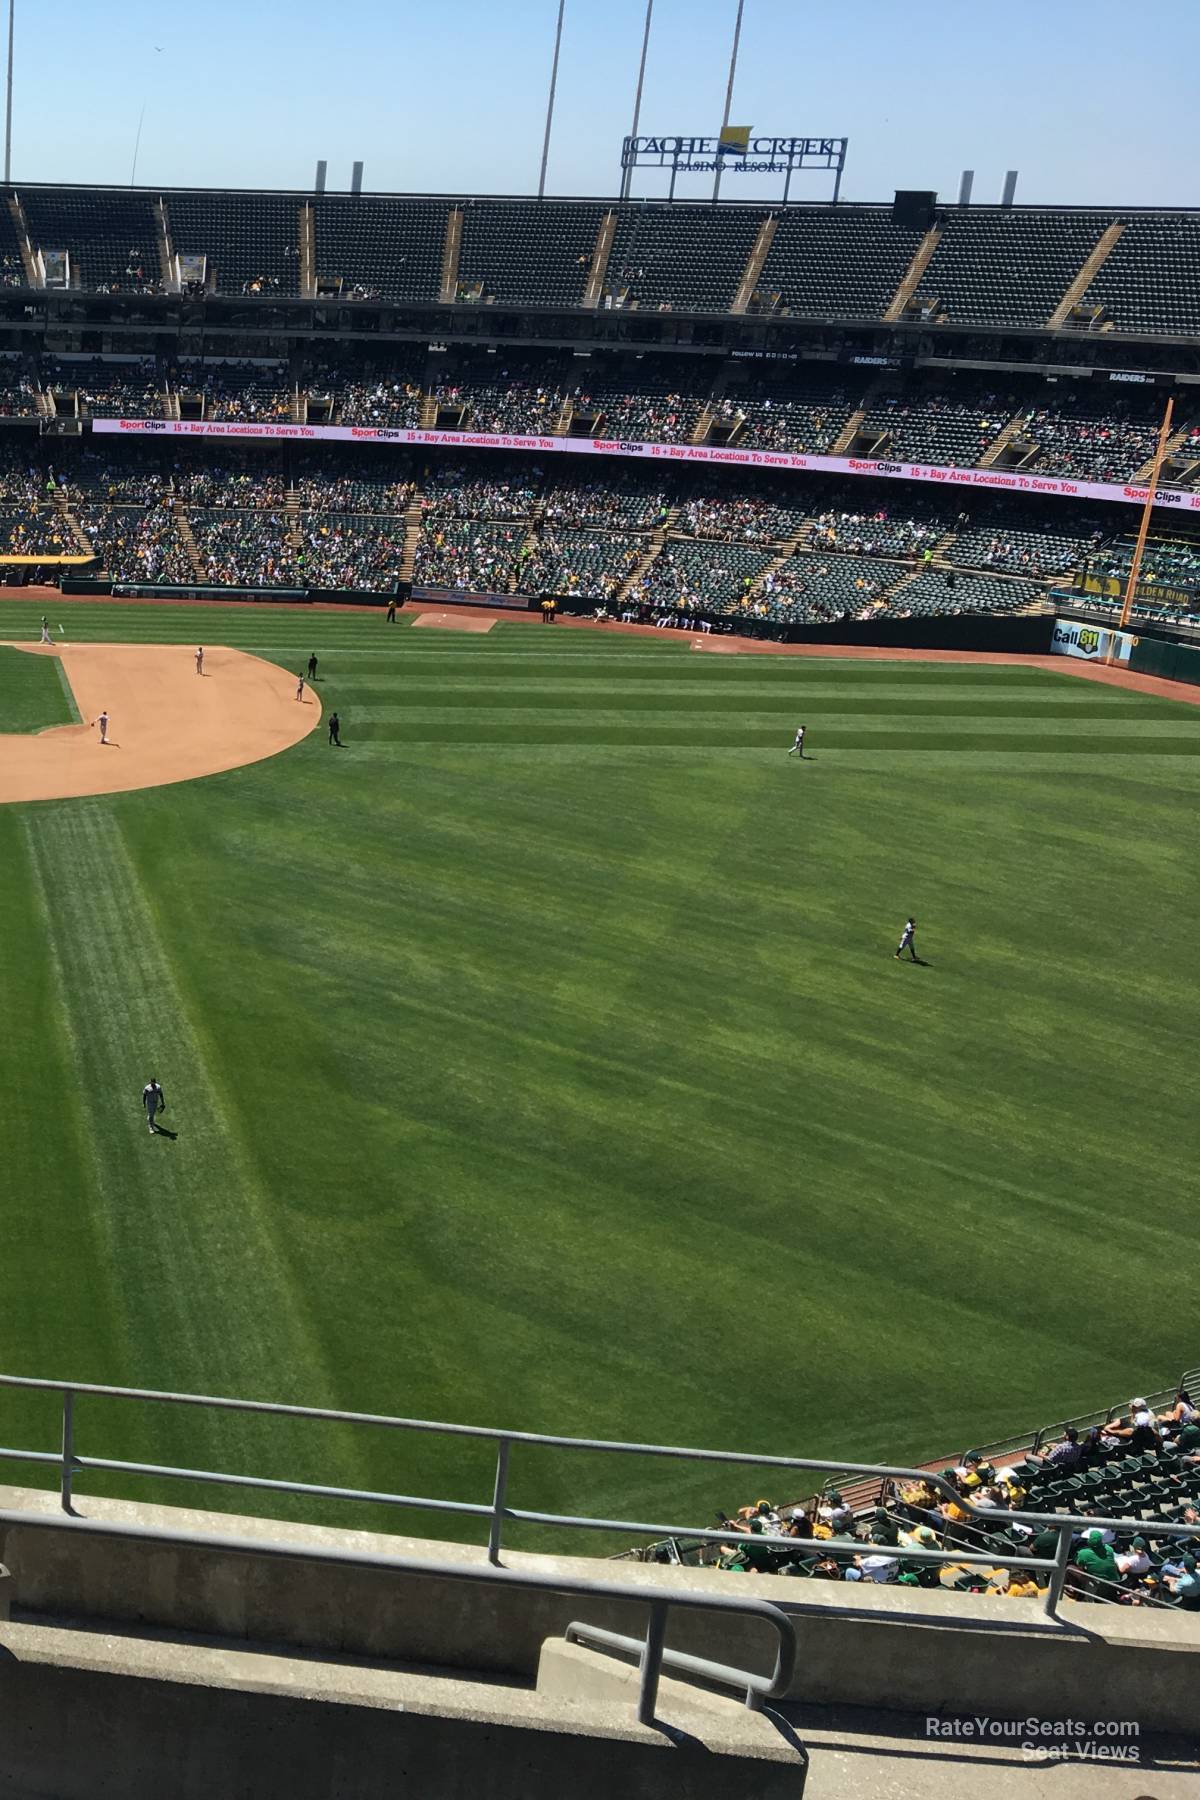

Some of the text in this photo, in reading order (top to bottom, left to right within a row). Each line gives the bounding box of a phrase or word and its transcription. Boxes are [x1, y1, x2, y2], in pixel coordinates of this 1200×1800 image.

[630, 137, 832, 154] CACHE CREEK
[675, 161, 786, 172] CASINO RESORT
[119, 420, 166, 430] SportClips
[173, 423, 182, 432] 15
[190, 424, 204, 433] Bay
[207, 424, 224, 433] Area
[227, 425, 262, 434] Locations
[265, 426, 275, 434] To
[276, 427, 298, 435] Serve
[300, 427, 315, 437] You
[351, 428, 399, 438] SportClips
[407, 432, 415, 440] 15
[425, 433, 439, 443] Bay
[441, 434, 459, 443] Area
[462, 435, 500, 445] Locations
[502, 436, 511, 445] To
[513, 437, 536, 447] Serve
[539, 438, 554, 448] You
[593, 440, 643, 452] SportClips
[651, 446, 660, 455] 15
[670, 448, 686, 458] Bay
[688, 449, 707, 458] Area
[710, 451, 749, 461] Locations
[752, 454, 762, 463] To
[764, 455, 788, 464] Serve
[791, 456, 807, 466] You
[848, 459, 902, 473] SportClips
[910, 467, 920, 477] 15
[930, 469, 947, 480] Bay
[949, 471, 971, 482] Area
[974, 473, 1016, 486] Locations
[1019, 478, 1030, 488] To
[1031, 479, 1058, 491] Serve
[1060, 482, 1077, 493] You
[1123, 487, 1182, 503] SporClips
[1053, 628, 1099, 647] Call 811
